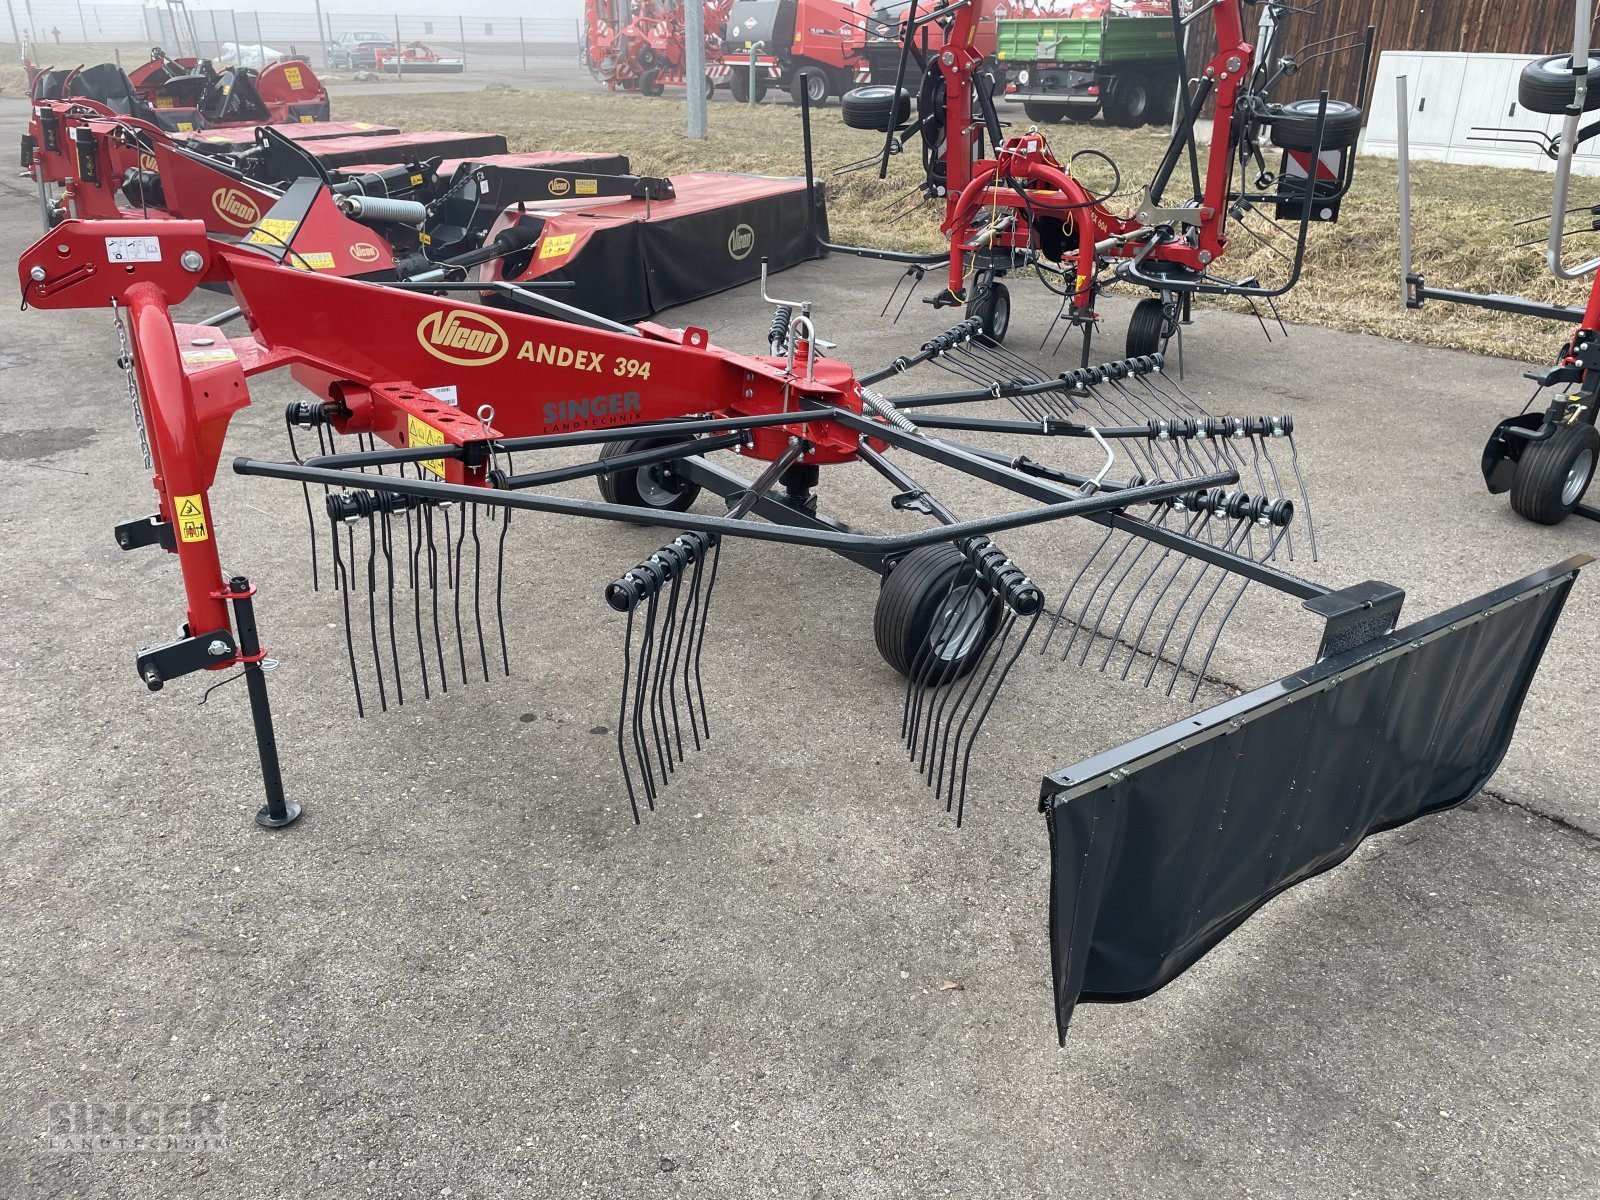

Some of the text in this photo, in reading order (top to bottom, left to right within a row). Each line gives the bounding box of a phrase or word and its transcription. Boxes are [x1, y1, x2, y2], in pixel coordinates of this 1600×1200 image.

[550, 179, 568, 192] Vicon
[217, 188, 258, 223] Vicon
[1098, 219, 1108, 233] 604
[353, 243, 377, 258] Vicon
[731, 226, 752, 252] Vicon
[427, 310, 652, 381] Vicon ANDEX 394
[543, 391, 641, 424] SINGER
[543, 412, 642, 434] LANDTECHNIK
